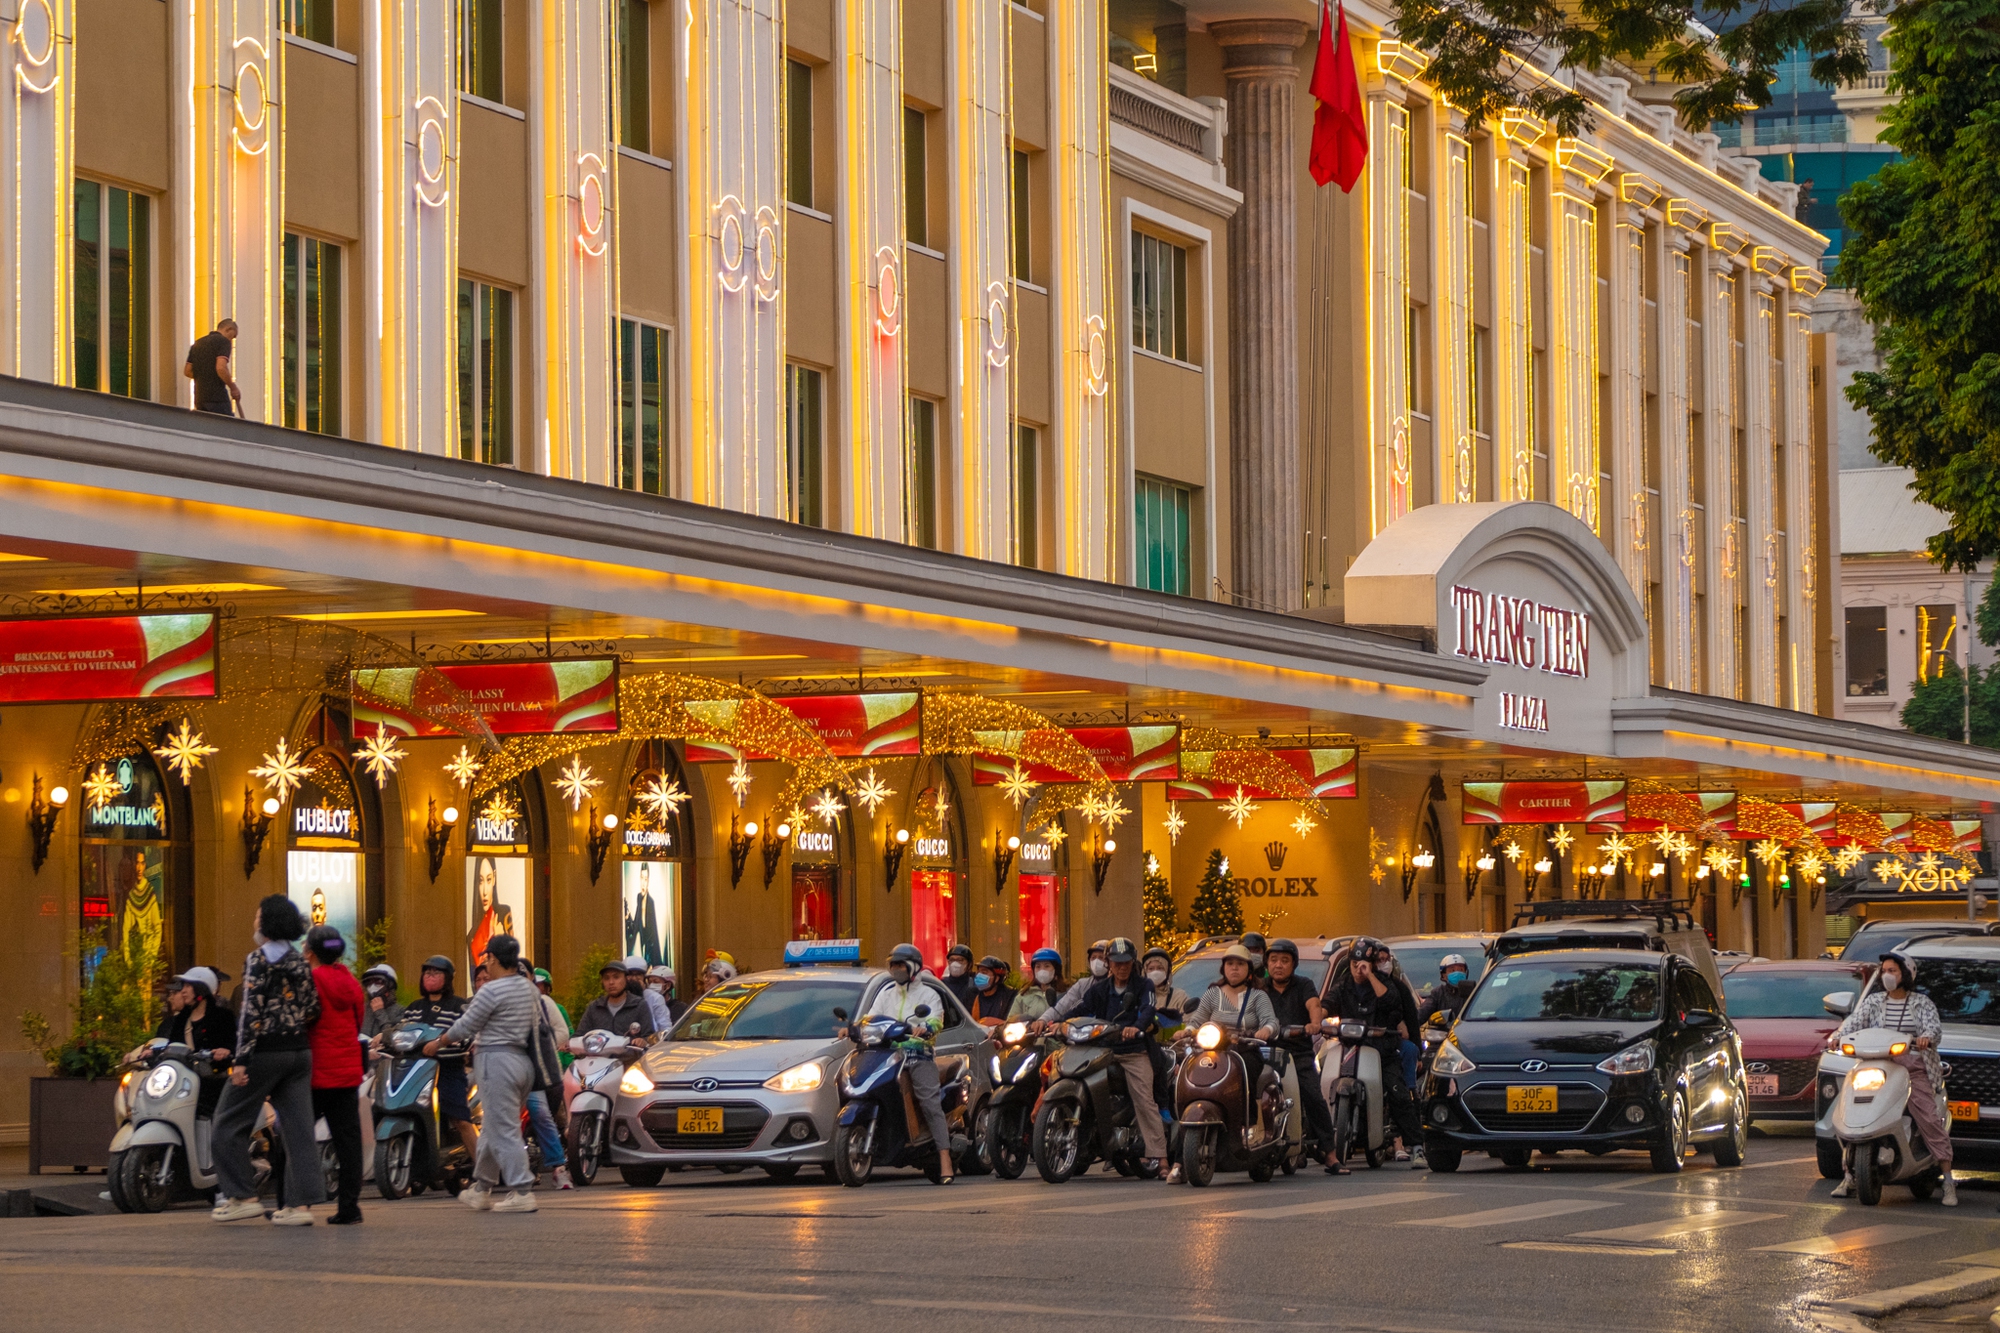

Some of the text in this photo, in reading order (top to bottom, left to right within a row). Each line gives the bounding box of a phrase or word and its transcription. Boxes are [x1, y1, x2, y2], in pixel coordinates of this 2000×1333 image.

[1451, 584, 1592, 679] TRANG TIEN
[14, 649, 115, 662] BRINGING WORLD'S
[73, 662, 87, 672] TO
[88, 660, 137, 671] VIETNAM
[1499, 691, 1550, 733] PLAZA
[818, 728, 854, 738] PLAZA
[1519, 798, 1573, 808] CARTIER
[92, 805, 158, 826] MONTBLANC
[296, 807, 351, 834] HUBLOT
[476, 818, 515, 842] VERSACE
[799, 832, 833, 851] GUCCI
[917, 838, 949, 856] GUCCI
[1023, 843, 1051, 861] GUCCI
[1233, 877, 1319, 897] ROLEX
[1749, 1075, 1767, 1085] 30K
[1521, 1088, 1543, 1099] 30F
[1512, 1100, 1553, 1111] 334.23
[690, 1109, 711, 1120] 30E
[682, 1121, 719, 1132] 461.12
